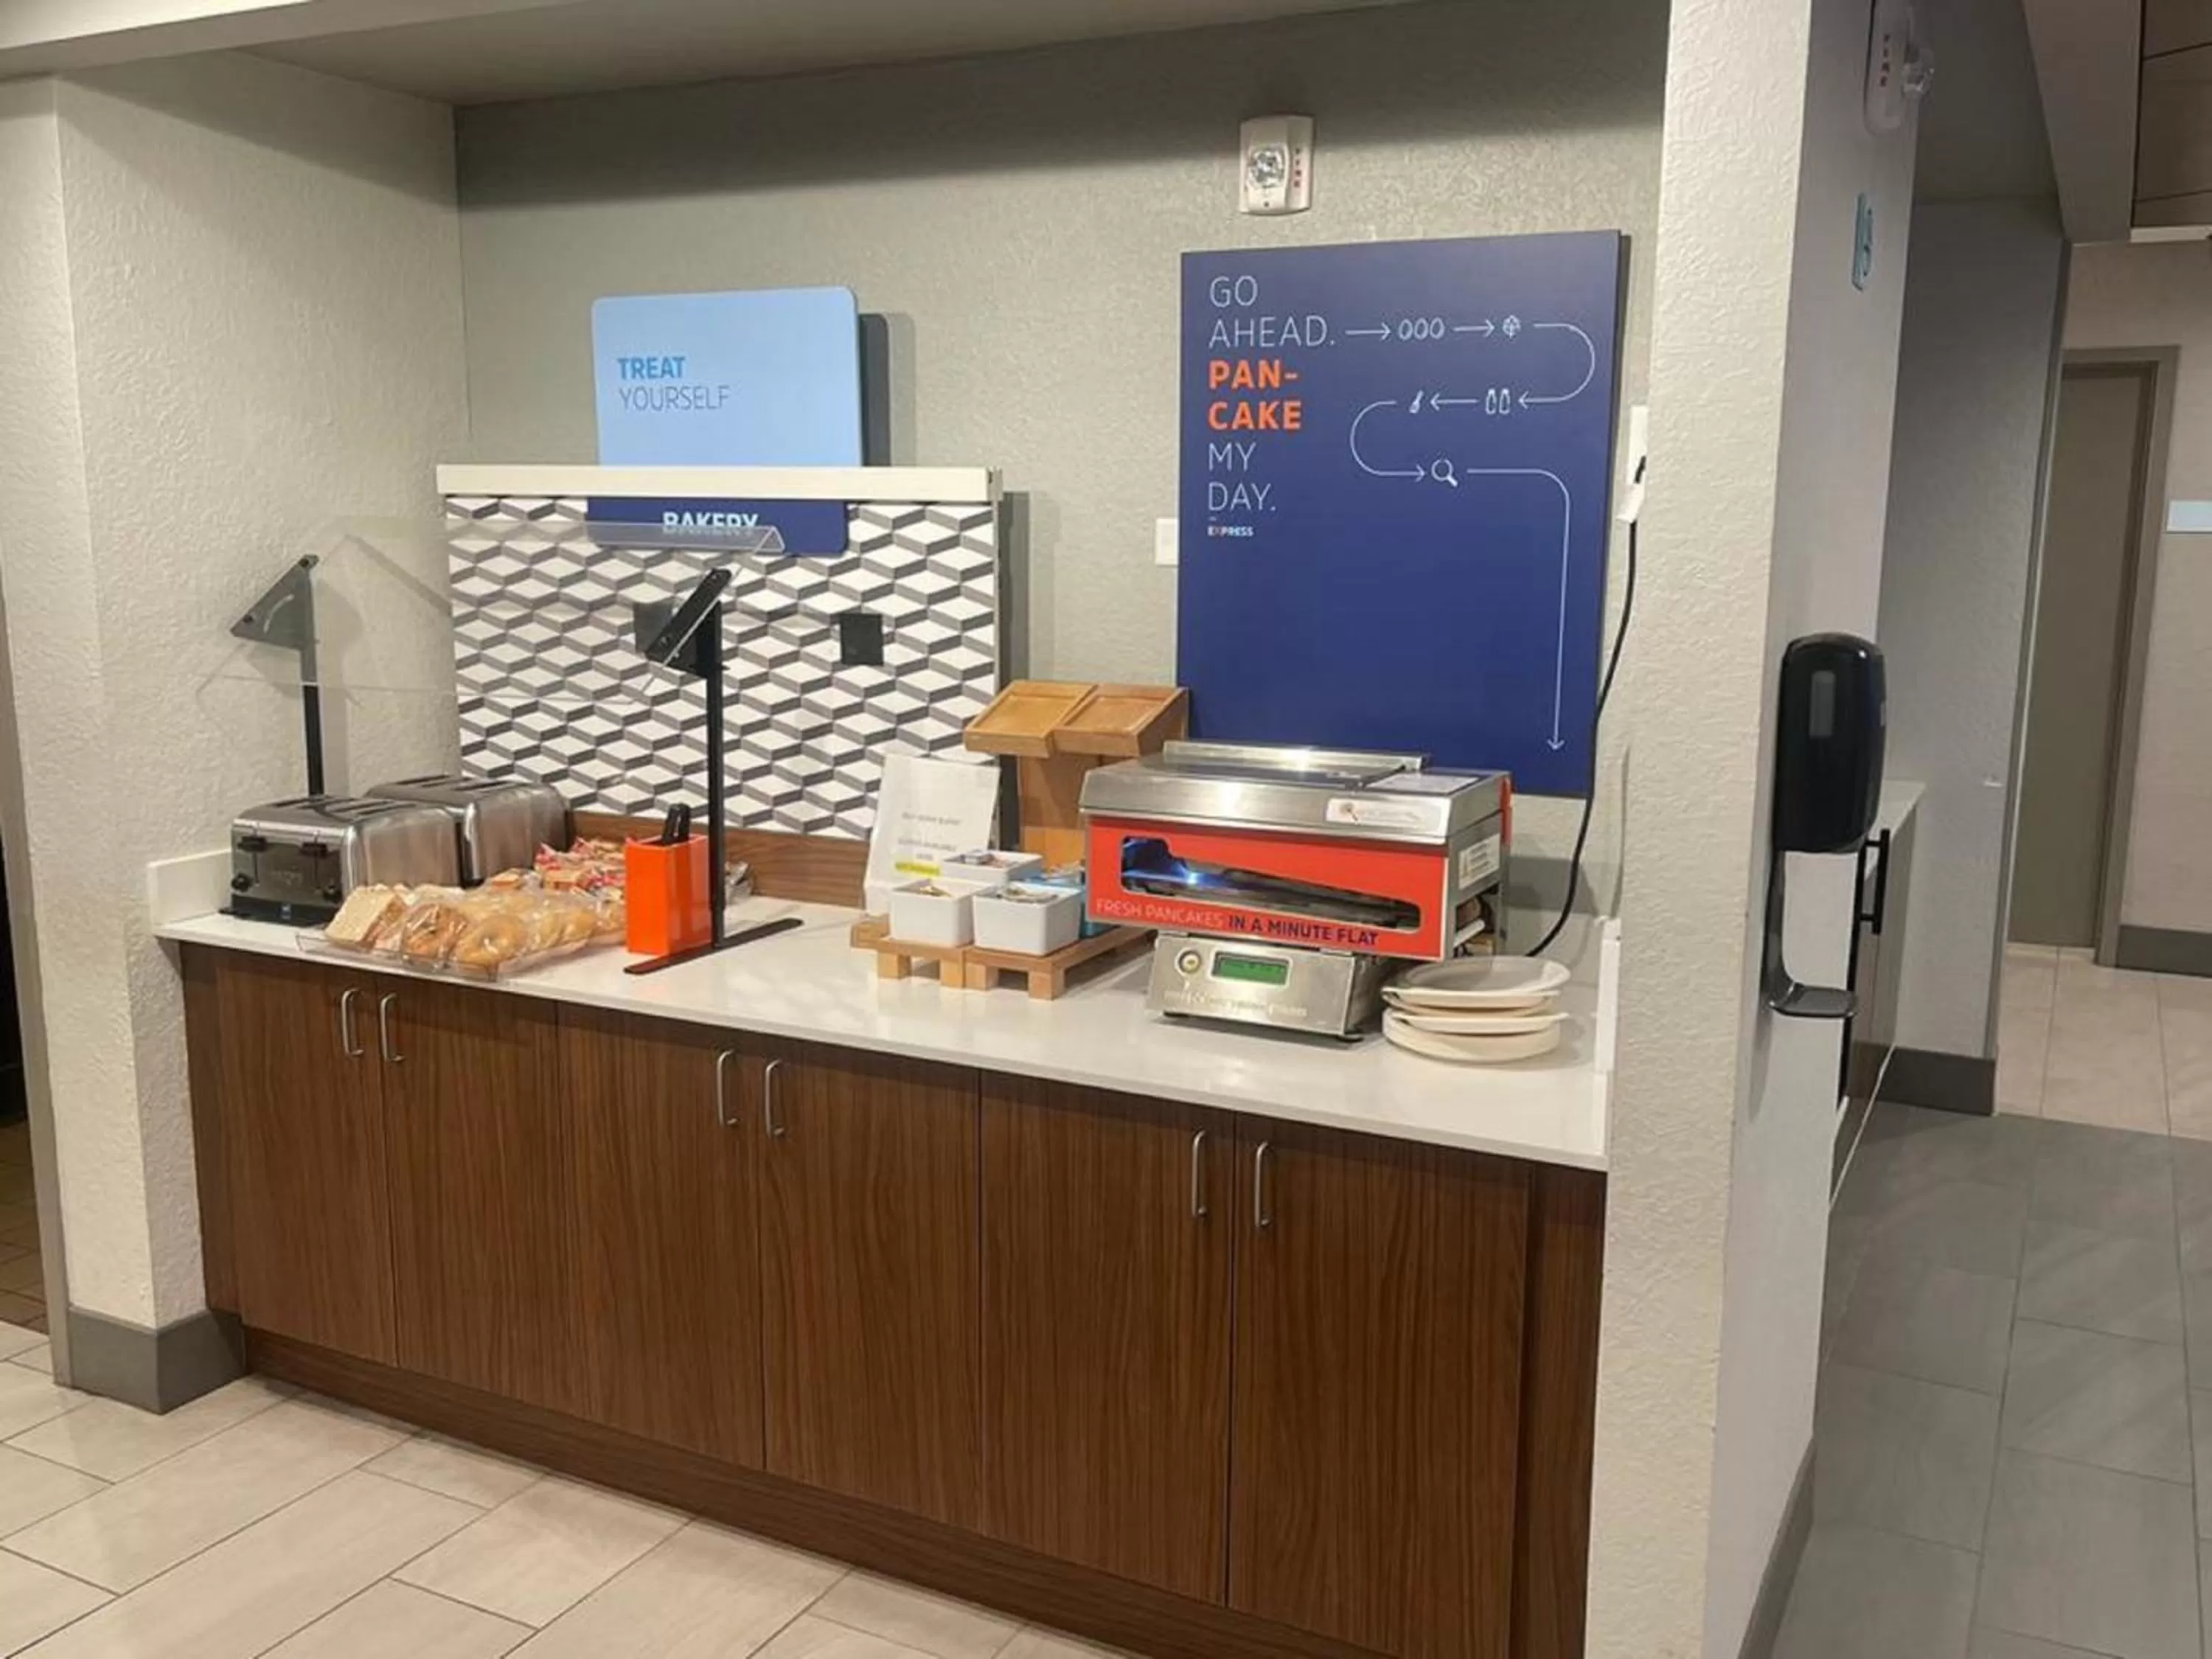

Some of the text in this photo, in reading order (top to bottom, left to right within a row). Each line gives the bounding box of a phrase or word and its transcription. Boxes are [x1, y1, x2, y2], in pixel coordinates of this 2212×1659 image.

[1208, 275, 1258, 307] GO
[1208, 315, 1336, 348] AHEAD.
[616, 356, 686, 380] TREAT
[1208, 360, 1299, 389] PAN-
[619, 385, 730, 411] YOURSELF
[1208, 400, 1302, 430] CAKE
[1208, 442, 1256, 471] MY
[1208, 483, 1276, 512] DAY.
[1207, 526, 1254, 537] EXPRESS
[1096, 898, 1379, 947] FRESH PANCAKES IN A MINUTE FLAT
